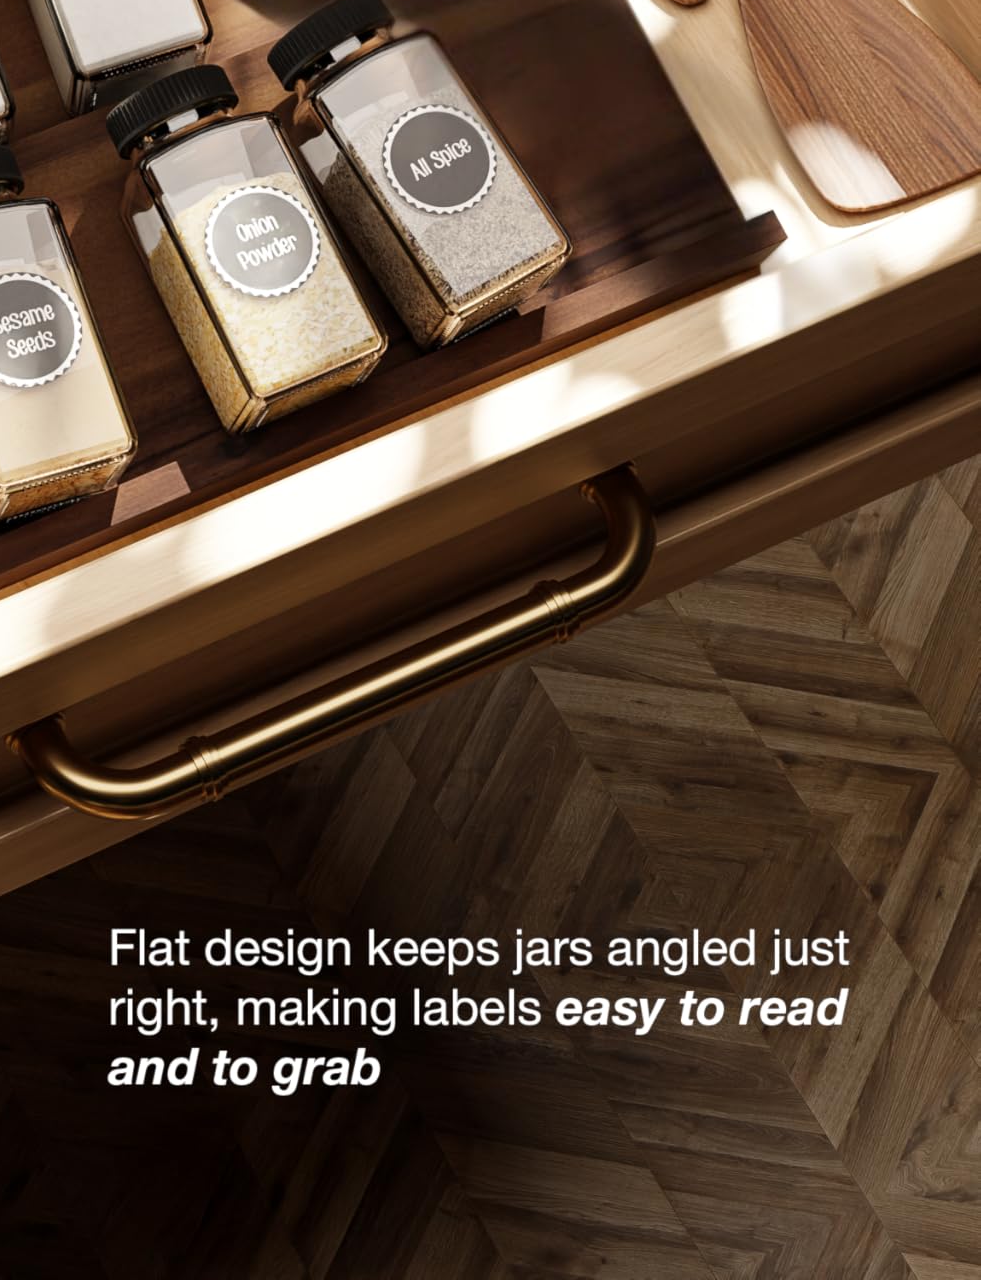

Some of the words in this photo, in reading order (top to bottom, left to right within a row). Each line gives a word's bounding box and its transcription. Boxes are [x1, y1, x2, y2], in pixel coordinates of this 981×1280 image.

[409, 157, 434, 182] All
[429, 138, 472, 170] Spice
[235, 215, 280, 243] Onion
[235, 234, 298, 271] Powder
[5, 330, 57, 360] Seeds
